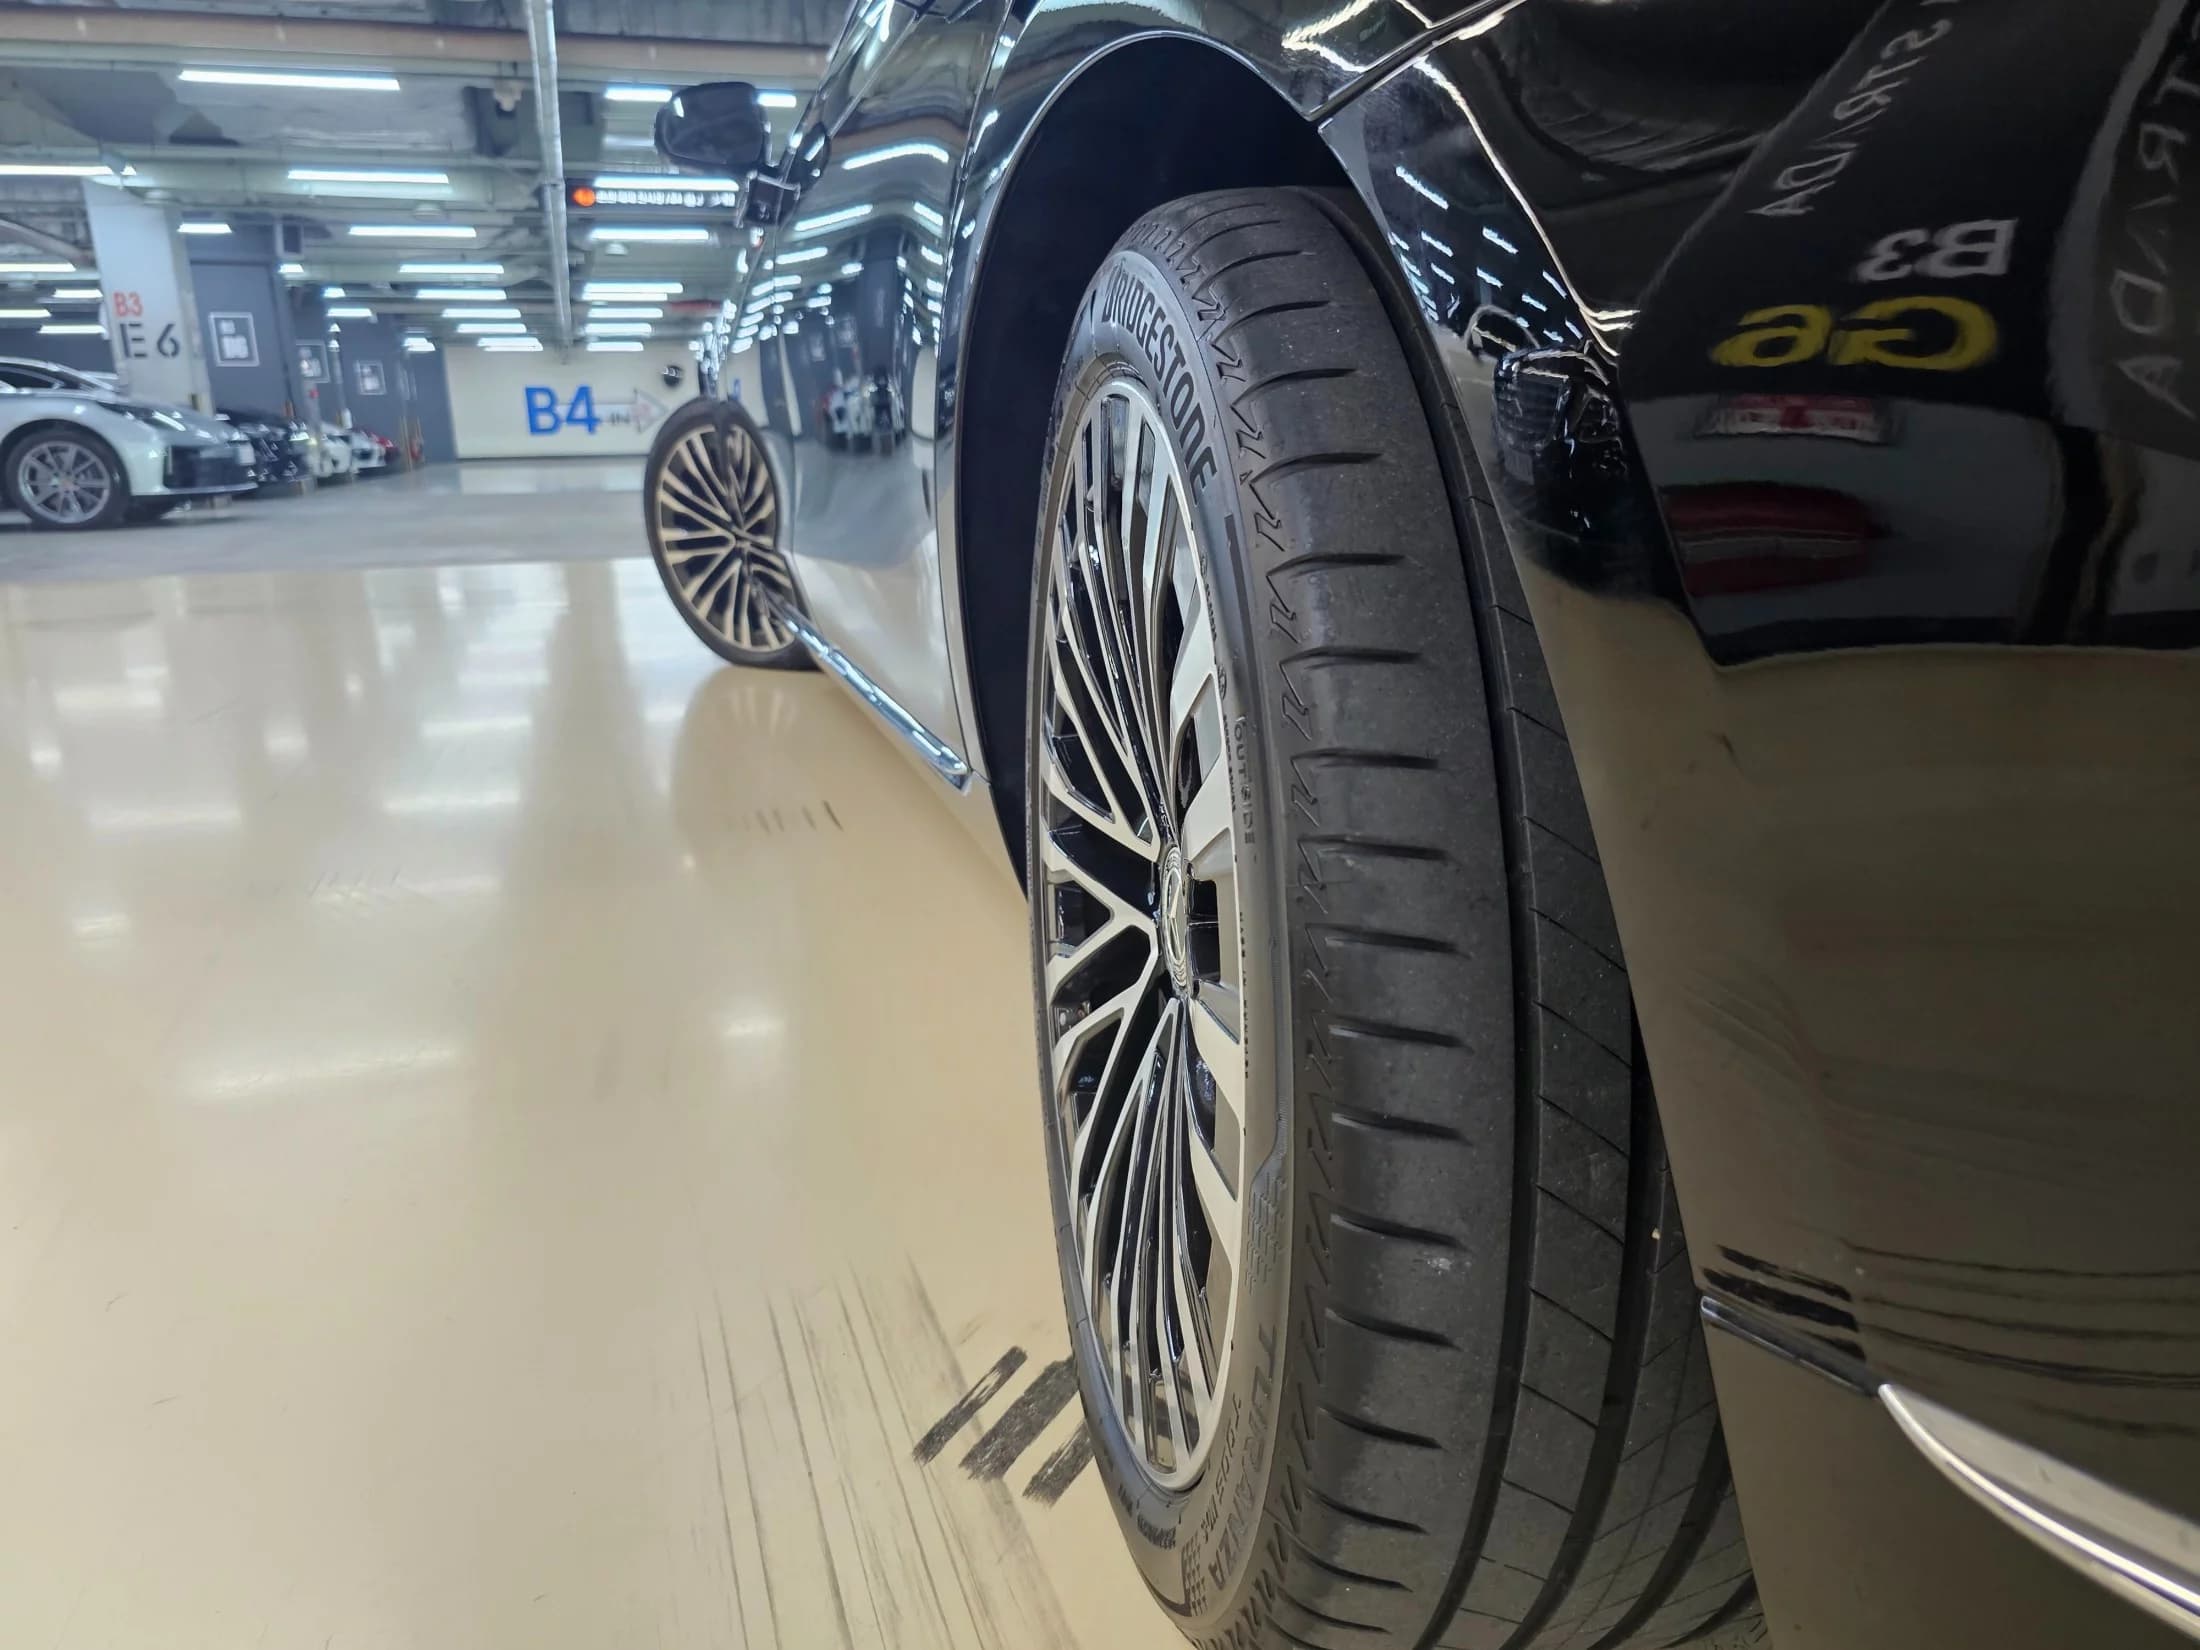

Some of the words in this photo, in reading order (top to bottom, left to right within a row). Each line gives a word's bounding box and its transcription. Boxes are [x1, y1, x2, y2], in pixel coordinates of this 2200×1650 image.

[112, 291, 144, 318] B3
[524, 384, 602, 436] B4
[1101, 261, 1217, 503] BRIDGESTONE
[1208, 1324, 1277, 1590] TURANZA
